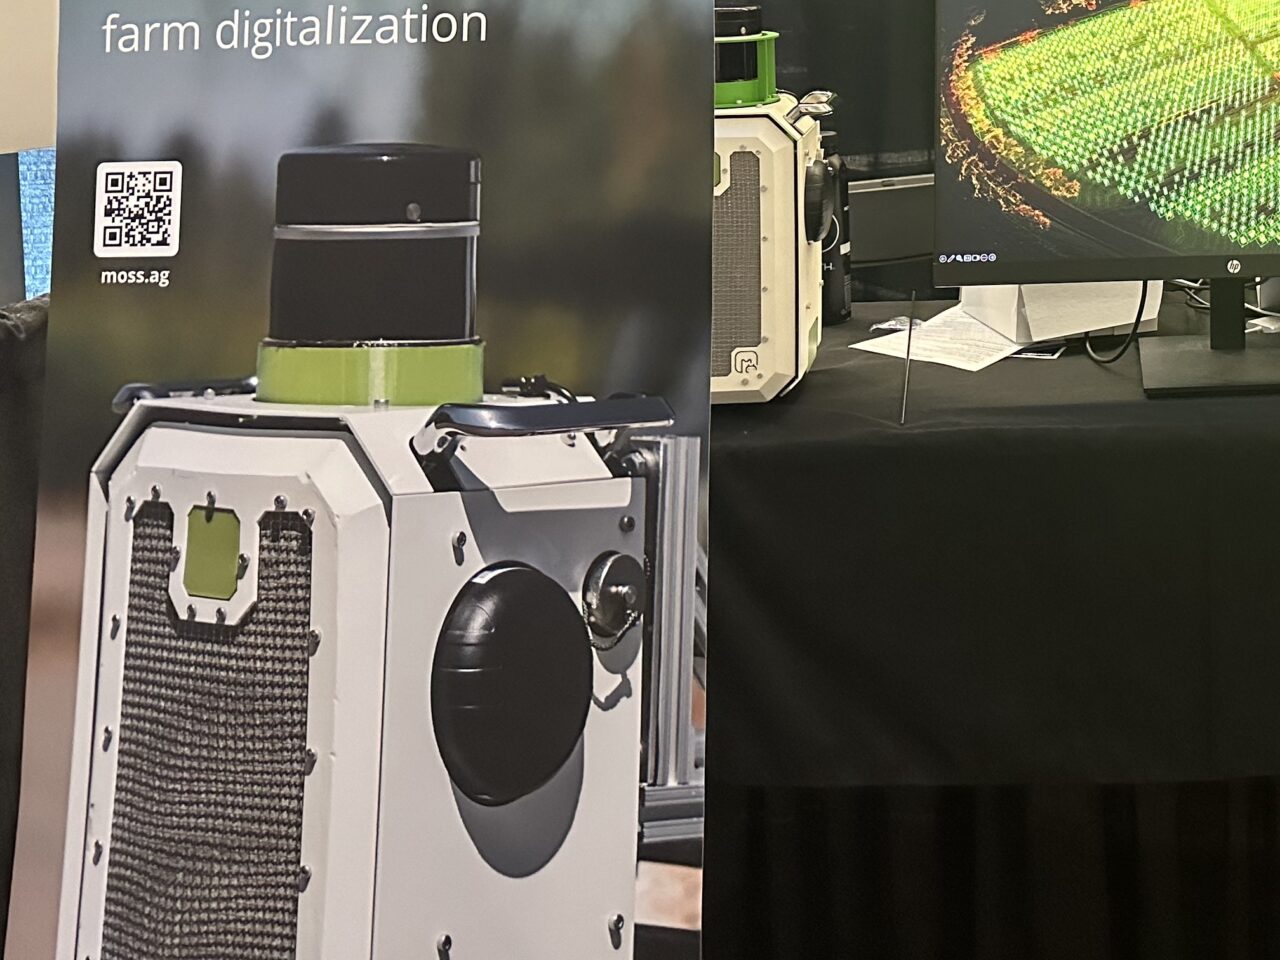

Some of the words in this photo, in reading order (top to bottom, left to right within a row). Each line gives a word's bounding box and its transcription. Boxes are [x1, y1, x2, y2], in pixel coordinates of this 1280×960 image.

[102, 13, 200, 53] farm
[215, 3, 487, 59] digitalization
[101, 270, 170, 287] moss.ag
